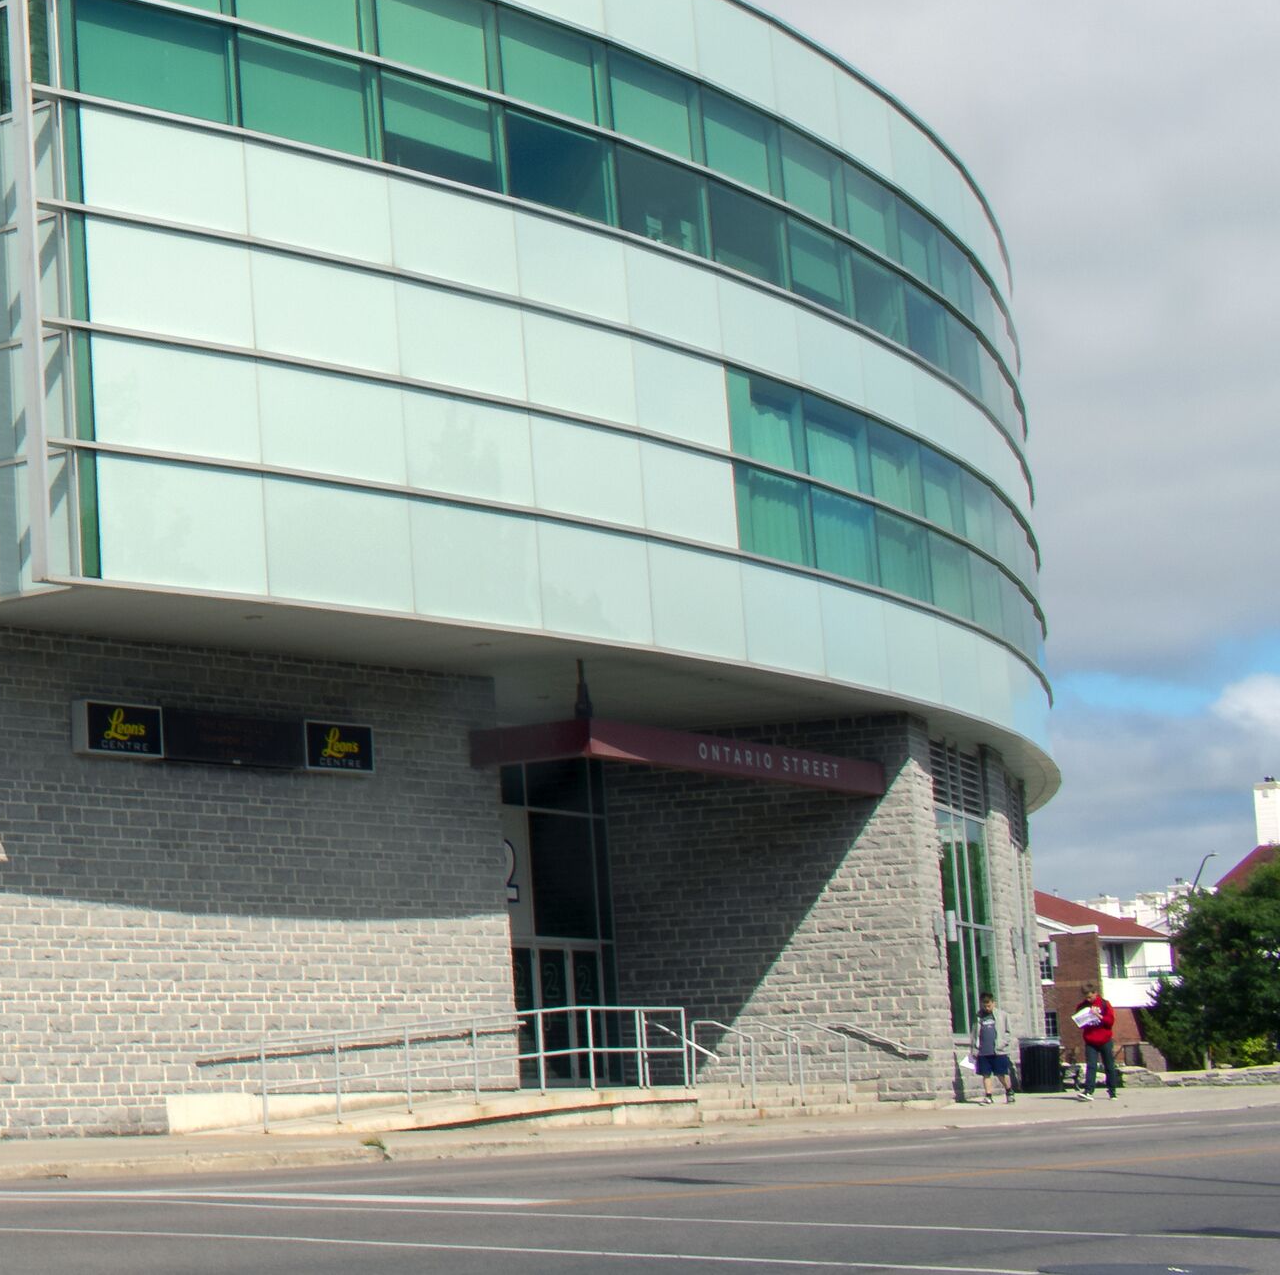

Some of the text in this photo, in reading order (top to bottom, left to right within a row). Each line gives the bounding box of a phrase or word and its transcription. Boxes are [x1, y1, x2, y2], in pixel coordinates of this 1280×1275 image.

[104, 707, 146, 741] Leon's
[101, 739, 150, 752] CENTRE
[321, 727, 360, 757] Leon's
[319, 757, 362, 768] CENTRE
[698, 742, 839, 779] ONTARIO STREET
